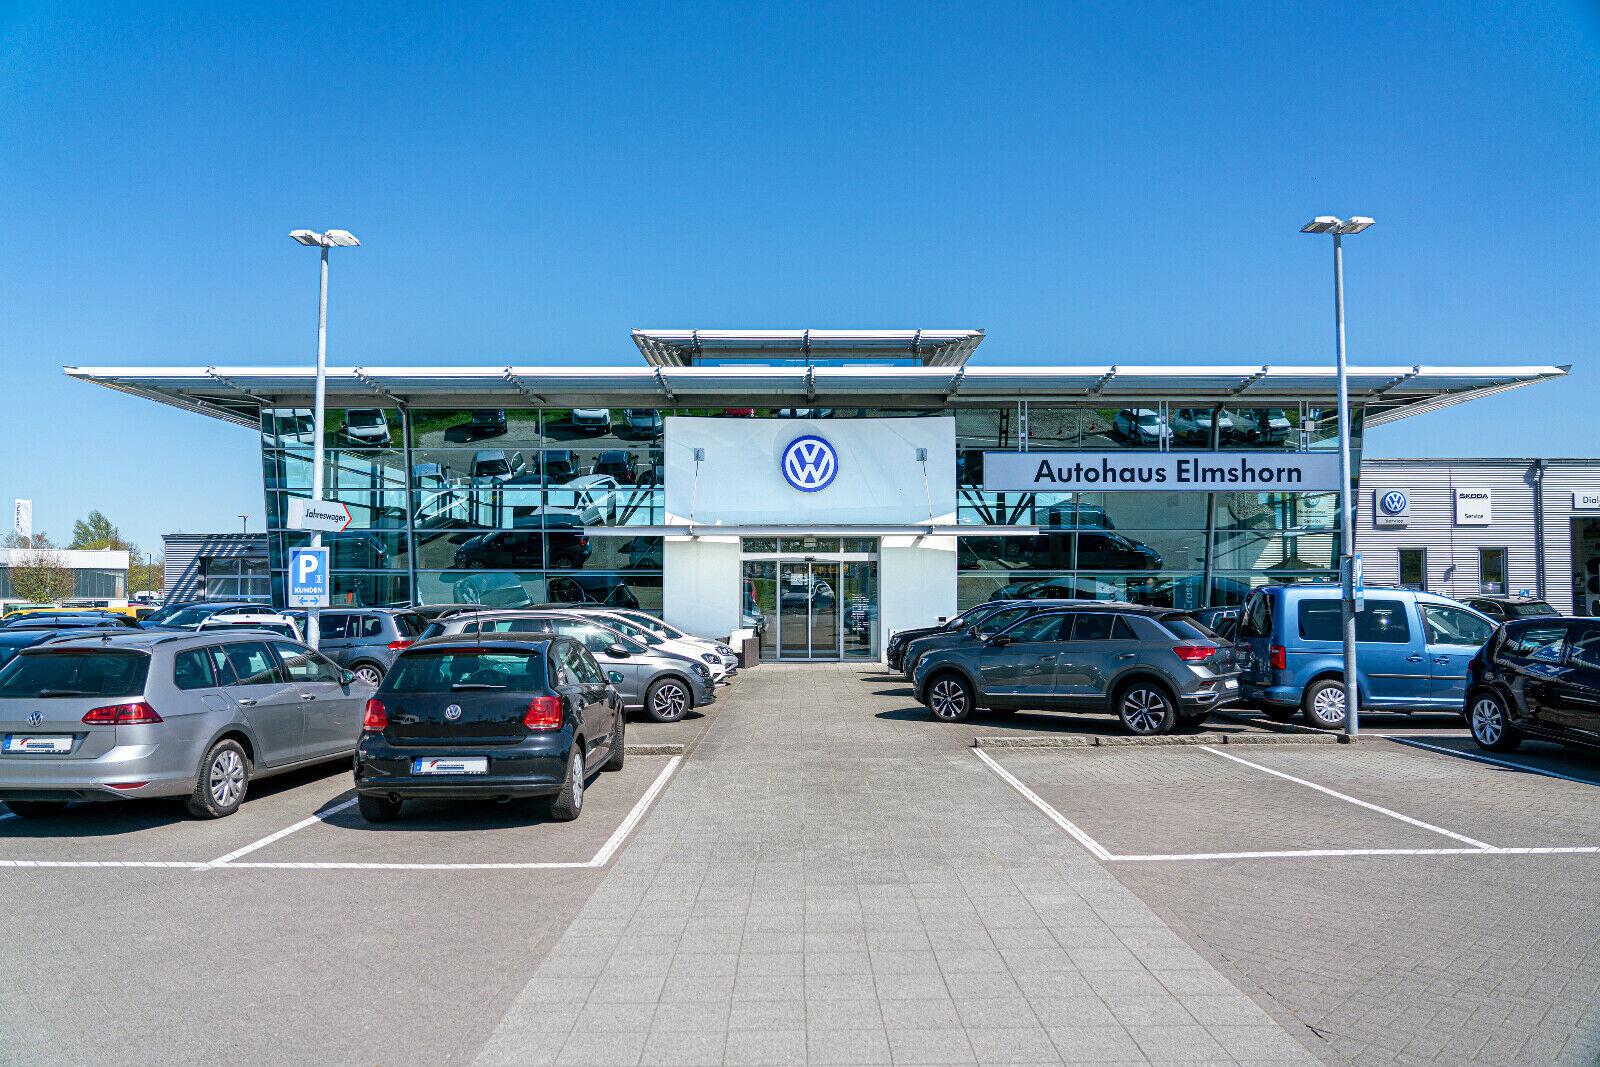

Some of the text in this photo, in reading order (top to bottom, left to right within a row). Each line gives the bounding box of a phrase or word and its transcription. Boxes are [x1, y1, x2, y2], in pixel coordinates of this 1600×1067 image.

[783, 437, 836, 490] VW
[1034, 458, 1302, 483] Autohaus Elmshorn
[1582, 495, 1600, 504] Dial
[305, 508, 346, 523] Jahreswagen
[299, 554, 319, 583] P
